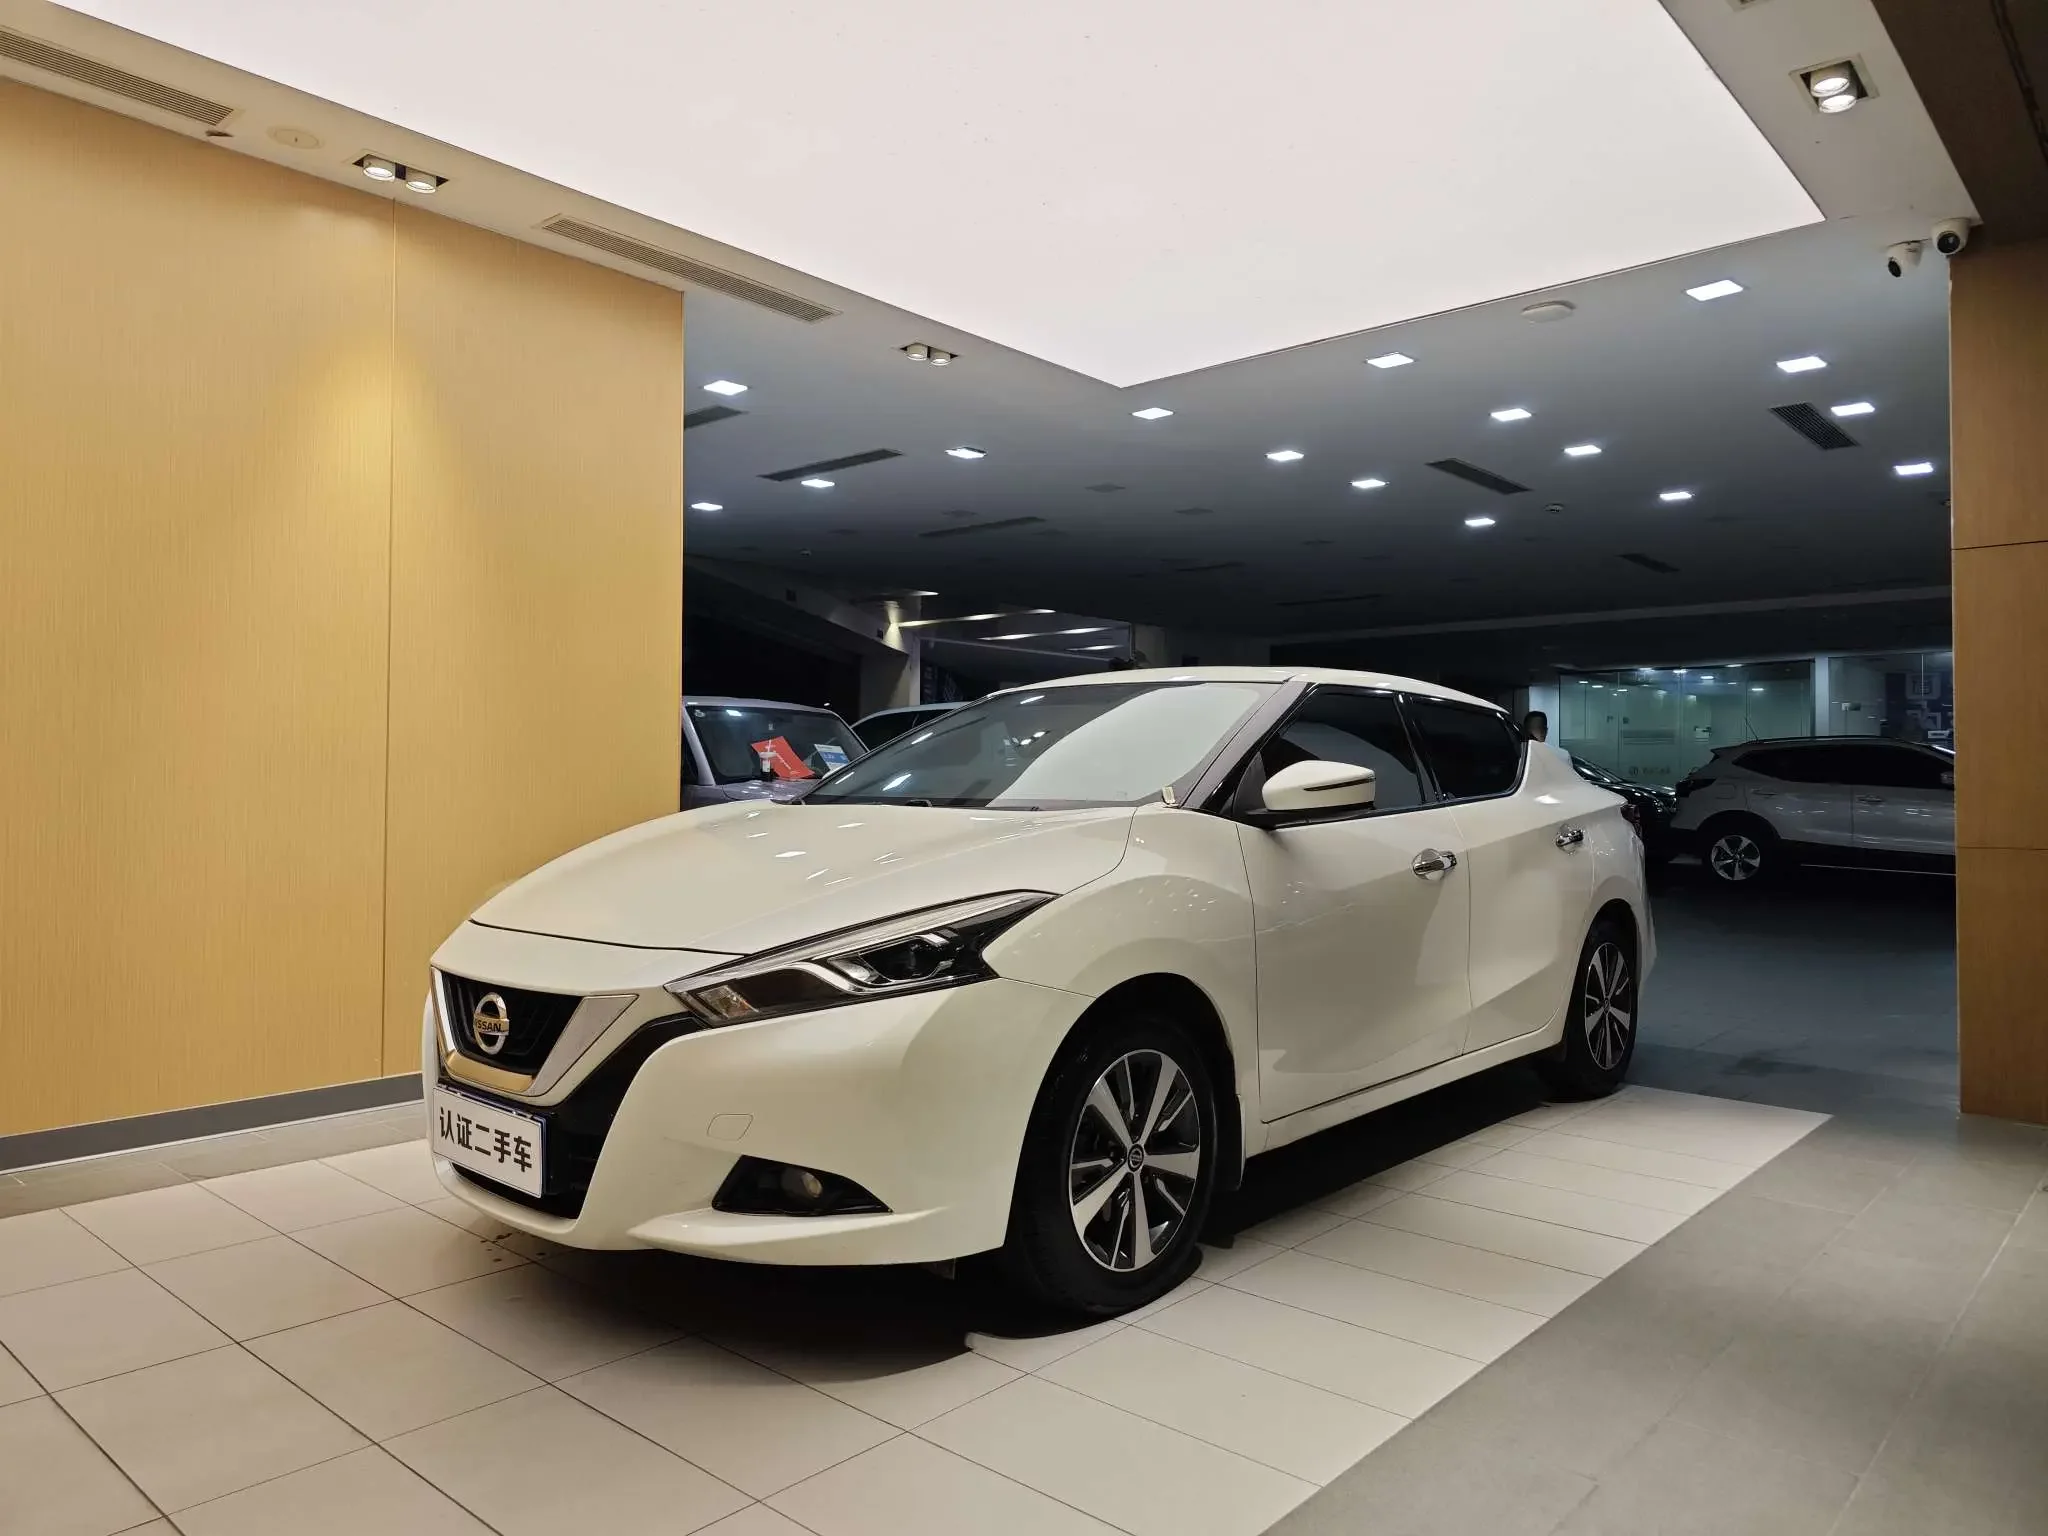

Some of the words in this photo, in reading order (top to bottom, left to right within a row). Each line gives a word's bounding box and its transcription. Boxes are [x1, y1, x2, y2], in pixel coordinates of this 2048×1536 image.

[439, 1106, 532, 1172] 认证二手车
